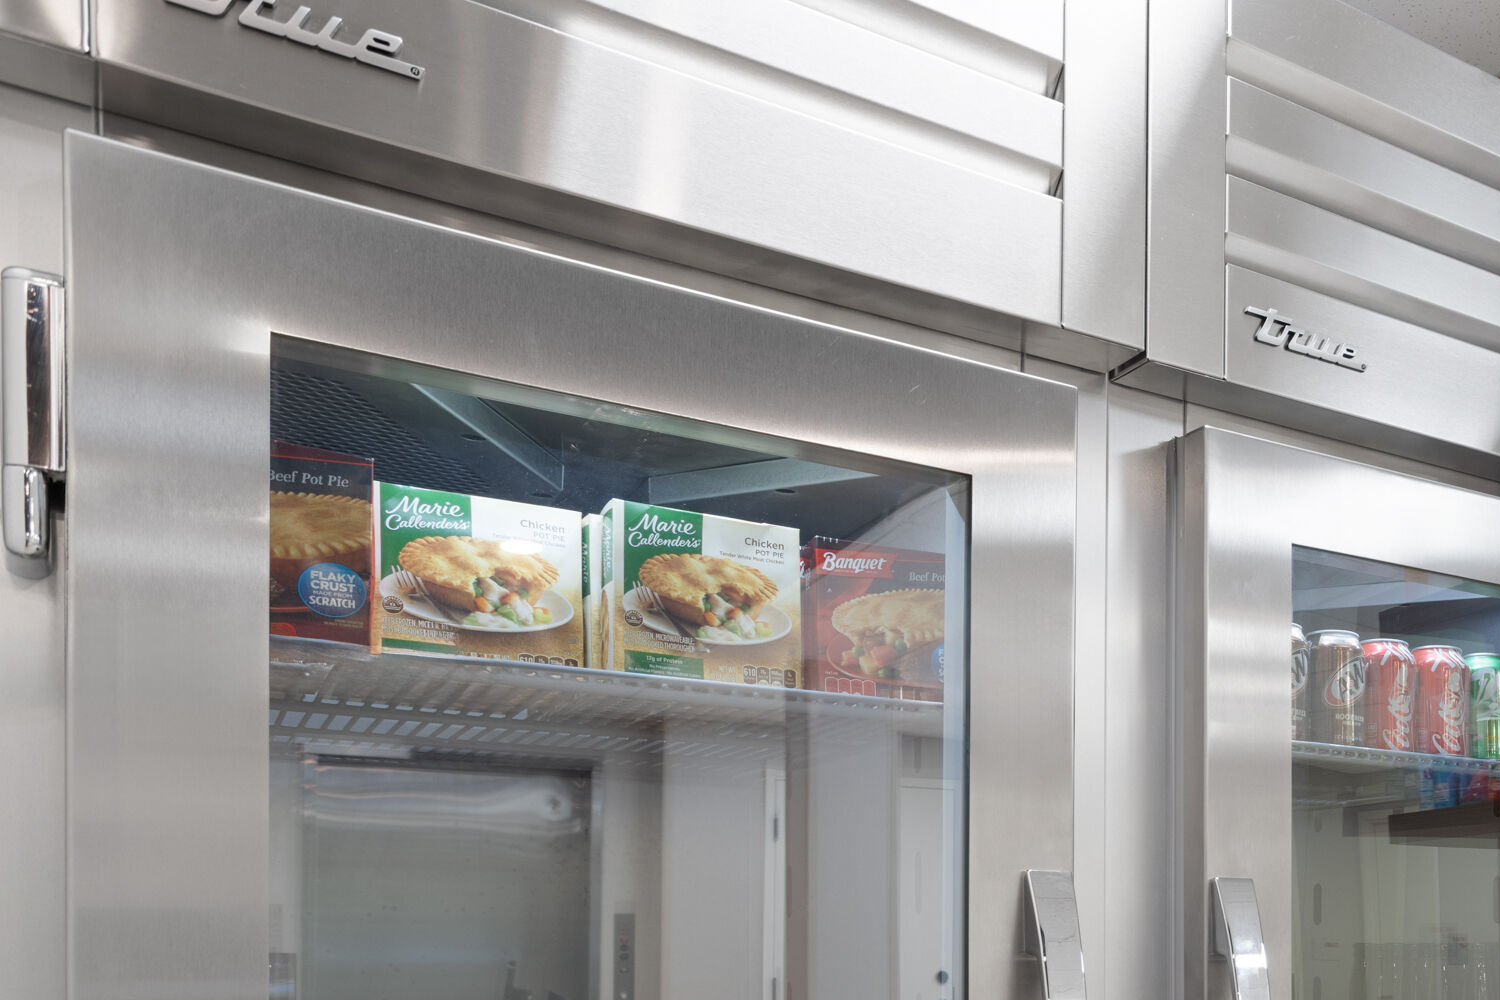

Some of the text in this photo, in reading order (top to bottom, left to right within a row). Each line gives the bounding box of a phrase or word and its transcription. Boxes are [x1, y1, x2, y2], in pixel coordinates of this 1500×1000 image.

[302, 473, 323, 486] Pot
[328, 475, 349, 488] Pie
[385, 496, 464, 517] Marie
[385, 514, 470, 531] Callender's
[520, 519, 565, 534] Chicken
[629, 513, 696, 535] Marie
[533, 530, 565, 541] POT PIE
[628, 532, 700, 548] Callender's
[744, 537, 785, 550] Chicken
[773, 551, 784, 559] PIE
[822, 552, 887, 573] Banquet
[310, 571, 355, 583] FLAKY
[909, 572, 928, 582] Beef
[310, 580, 355, 593] CRUST
[309, 595, 355, 609] SCRATCH
